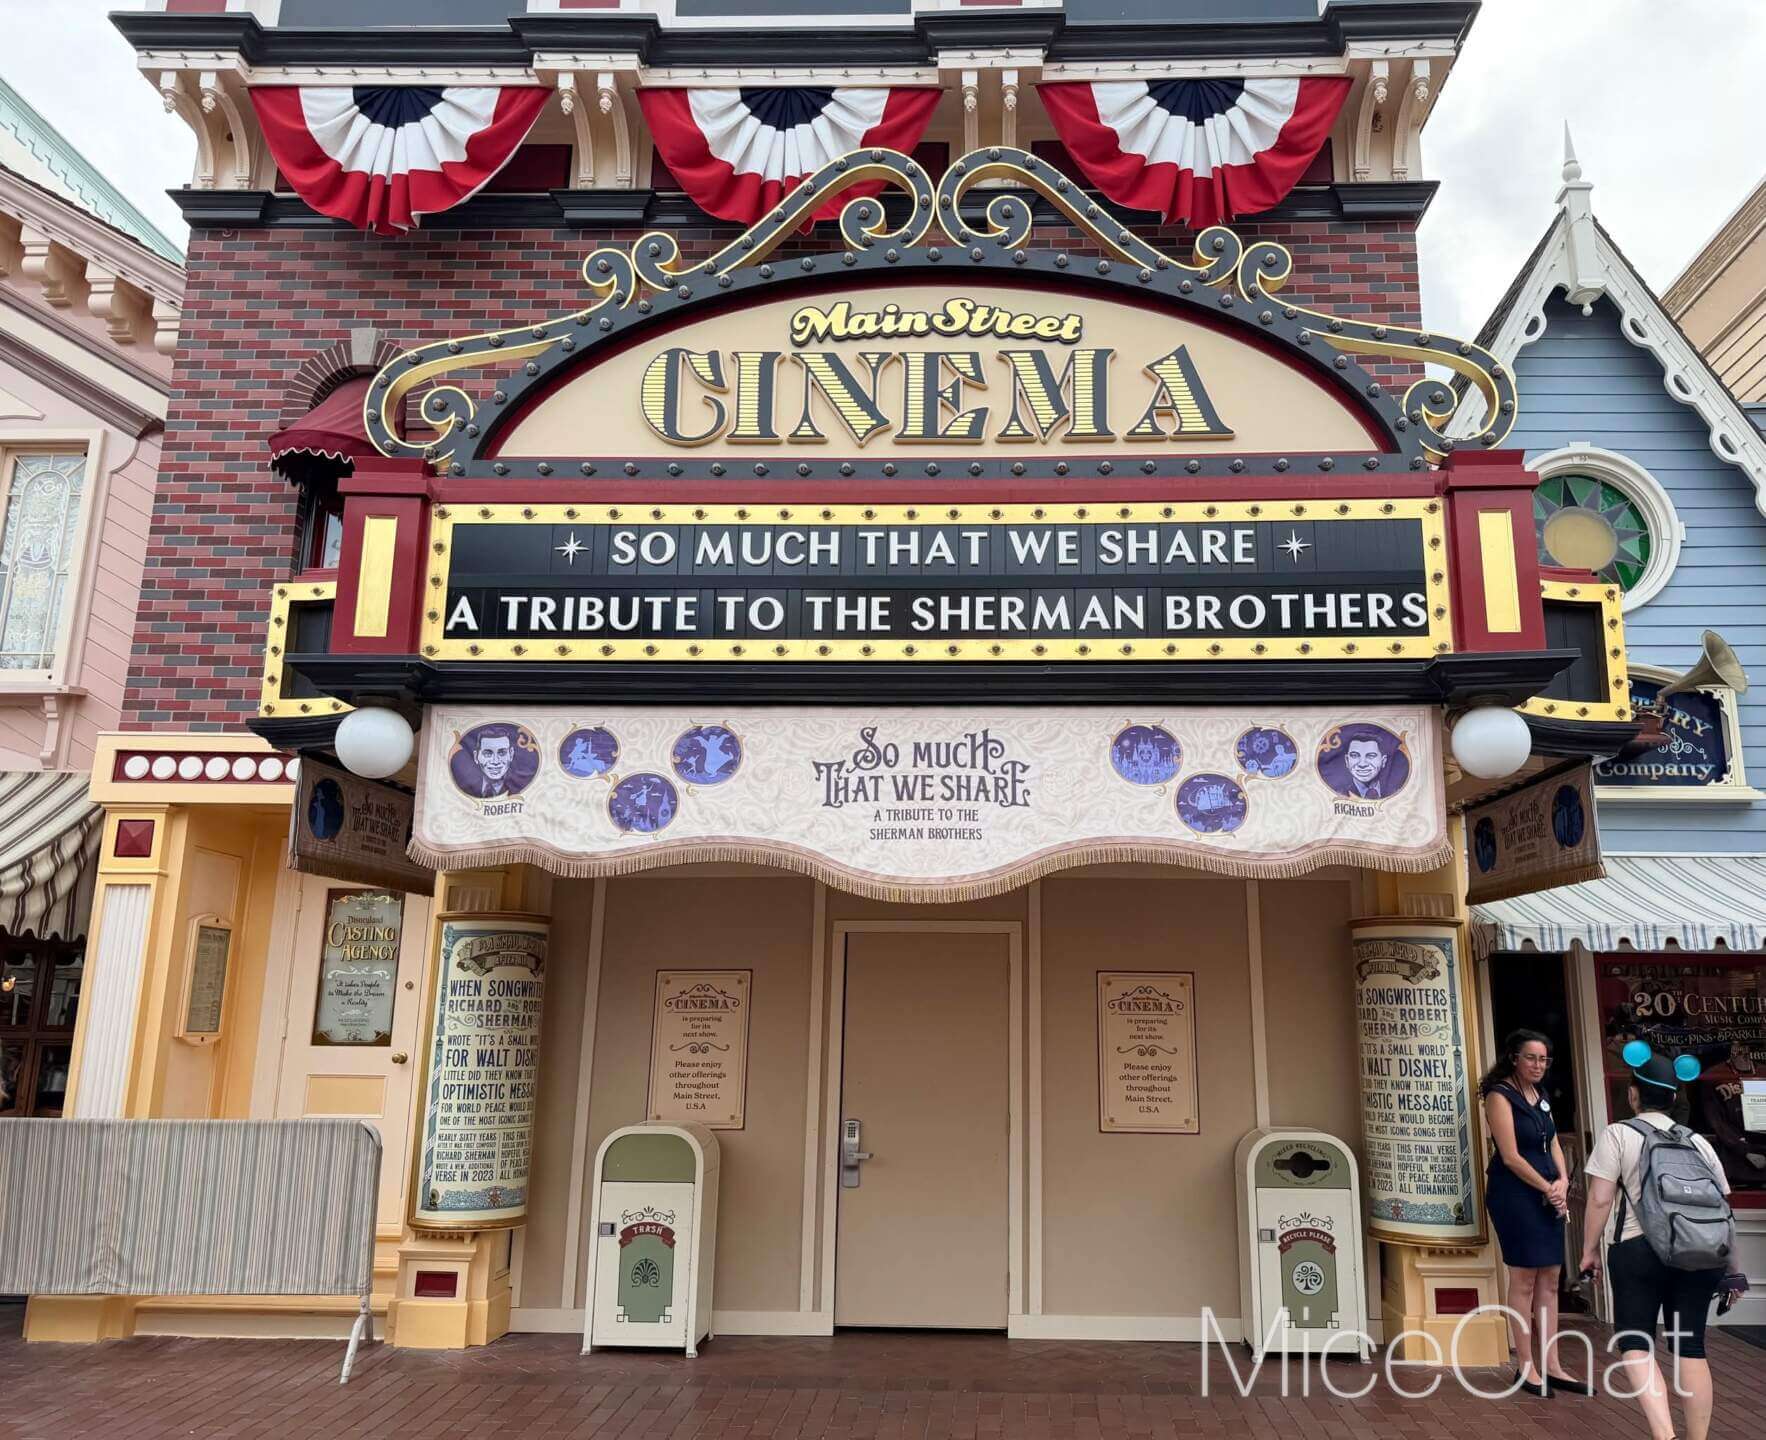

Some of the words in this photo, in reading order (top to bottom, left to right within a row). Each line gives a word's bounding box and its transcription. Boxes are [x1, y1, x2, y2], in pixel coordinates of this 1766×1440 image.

[790, 301, 930, 345] Main
[929, 297, 1086, 344] Street
[640, 344, 1236, 448] CINEMA
[611, 530, 677, 566] SO
[695, 530, 840, 566] MUCH
[858, 529, 989, 566] THAT
[1008, 529, 1079, 566] WE
[1099, 528, 1256, 566] SHARE
[445, 595, 479, 631] A
[500, 596, 698, 632] TRIBUTE
[717, 596, 785, 632] TO
[805, 596, 892, 632] THE
[910, 595, 1144, 632] SHERMAN
[1165, 592, 1428, 631] BROTHERS
[1596, 762, 1715, 780] Company
[892, 774, 935, 802] WE
[940, 760, 1031, 808] SHARE
[483, 802, 524, 816] ROBERT
[873, 809, 882, 822] A
[886, 808, 934, 822] TRIBUTE
[938, 809, 954, 821] TO
[956, 809, 979, 822] THE
[1333, 802, 1375, 817] RICHARD
[870, 827, 924, 841] SHERMAN
[927, 827, 983, 841] BROTHERS
[328, 922, 395, 948] CASTING
[341, 945, 398, 962] AGENCY
[450, 979, 482, 997] WHEN
[1366, 988, 1448, 1006] SONGWRITERS
[448, 999, 503, 1013] RICHARD
[674, 999, 730, 1009] CINEMA
[1117, 1001, 1174, 1012] CINEMA
[476, 1014, 533, 1029] SHERMAN
[1399, 1008, 1448, 1023] ROBERT
[1704, 1014, 1734, 1025] MUSIC
[1363, 1022, 1419, 1039] SHERMAN
[447, 1034, 471, 1046] WROTE
[498, 1035, 504, 1046] A
[507, 1034, 528, 1046] SMALL
[1380, 1044, 1385, 1055] A
[1387, 1044, 1414, 1056] SMALL
[445, 1048, 469, 1068] FOR
[476, 1048, 511, 1068] WALT
[675, 1060, 700, 1068] Please
[701, 1060, 722, 1070] enjoy
[1123, 1063, 1149, 1071] Please
[1150, 1064, 1172, 1072] enjoy
[1367, 1057, 1393, 1077] WALT
[1398, 1058, 1452, 1079] DISNEY,
[443, 1070, 465, 1081] LITTLE
[468, 1070, 481, 1081] DID
[484, 1070, 503, 1081] THEY
[505, 1070, 522, 1081] KNOW
[669, 1070, 691, 1079] other
[691, 1070, 727, 1080] offerings
[1118, 1073, 1140, 1081] other
[1141, 1073, 1178, 1083] offerings
[442, 1083, 505, 1100] OPTIMISTIC
[675, 1081, 719, 1091] throughout
[1125, 1085, 1171, 1093] throughout
[1374, 1079, 1388, 1090] THEY
[1390, 1080, 1411, 1091] KNOW
[1415, 1080, 1433, 1091] THAT
[1437, 1080, 1453, 1092] THIS
[673, 1091, 693, 1100] Main
[694, 1091, 721, 1101] Street,
[1125, 1095, 1145, 1103] Main
[1146, 1096, 1173, 1104] Street,
[1397, 1093, 1454, 1111] MESSAGE
[441, 1102, 453, 1113] FOR
[456, 1102, 481, 1113] WORLD
[485, 1102, 506, 1113] PEACE
[440, 1116, 451, 1126] ONE
[453, 1116, 461, 1126] OF
[464, 1115, 477, 1126] THE
[479, 1115, 497, 1126] MOST
[1377, 1111, 1396, 1123] PEACE
[1399, 1113, 1425, 1125] WOULD
[1428, 1114, 1455, 1125] BECOME
[459, 1132, 477, 1142] SIXTY
[479, 1132, 497, 1141] YEARS
[1413, 1127, 1436, 1137] SONGS
[1397, 1143, 1411, 1154] THIS
[1414, 1143, 1434, 1155] FINAL
[1437, 1145, 1457, 1155] VERSE
[436, 1151, 462, 1161] RICHARD
[464, 1151, 496, 1161] SHERMAN
[1397, 1162, 1424, 1173] HOPEFUL
[1429, 1163, 1458, 1173] MESSAGE
[435, 1171, 457, 1182] VERSE
[460, 1171, 469, 1182] IN
[472, 1170, 494, 1182] 2023
[1397, 1172, 1406, 1182] OF
[1409, 1173, 1430, 1184] PEACE
[1433, 1174, 1459, 1184] ACROSS
[1399, 1182, 1413, 1194] ALL
[1416, 1183, 1459, 1196] HUMANKIND
[631, 1225, 664, 1235] TRASH
[1282, 1231, 1308, 1243] RECYCLE
[1309, 1231, 1334, 1244] PLEASE
